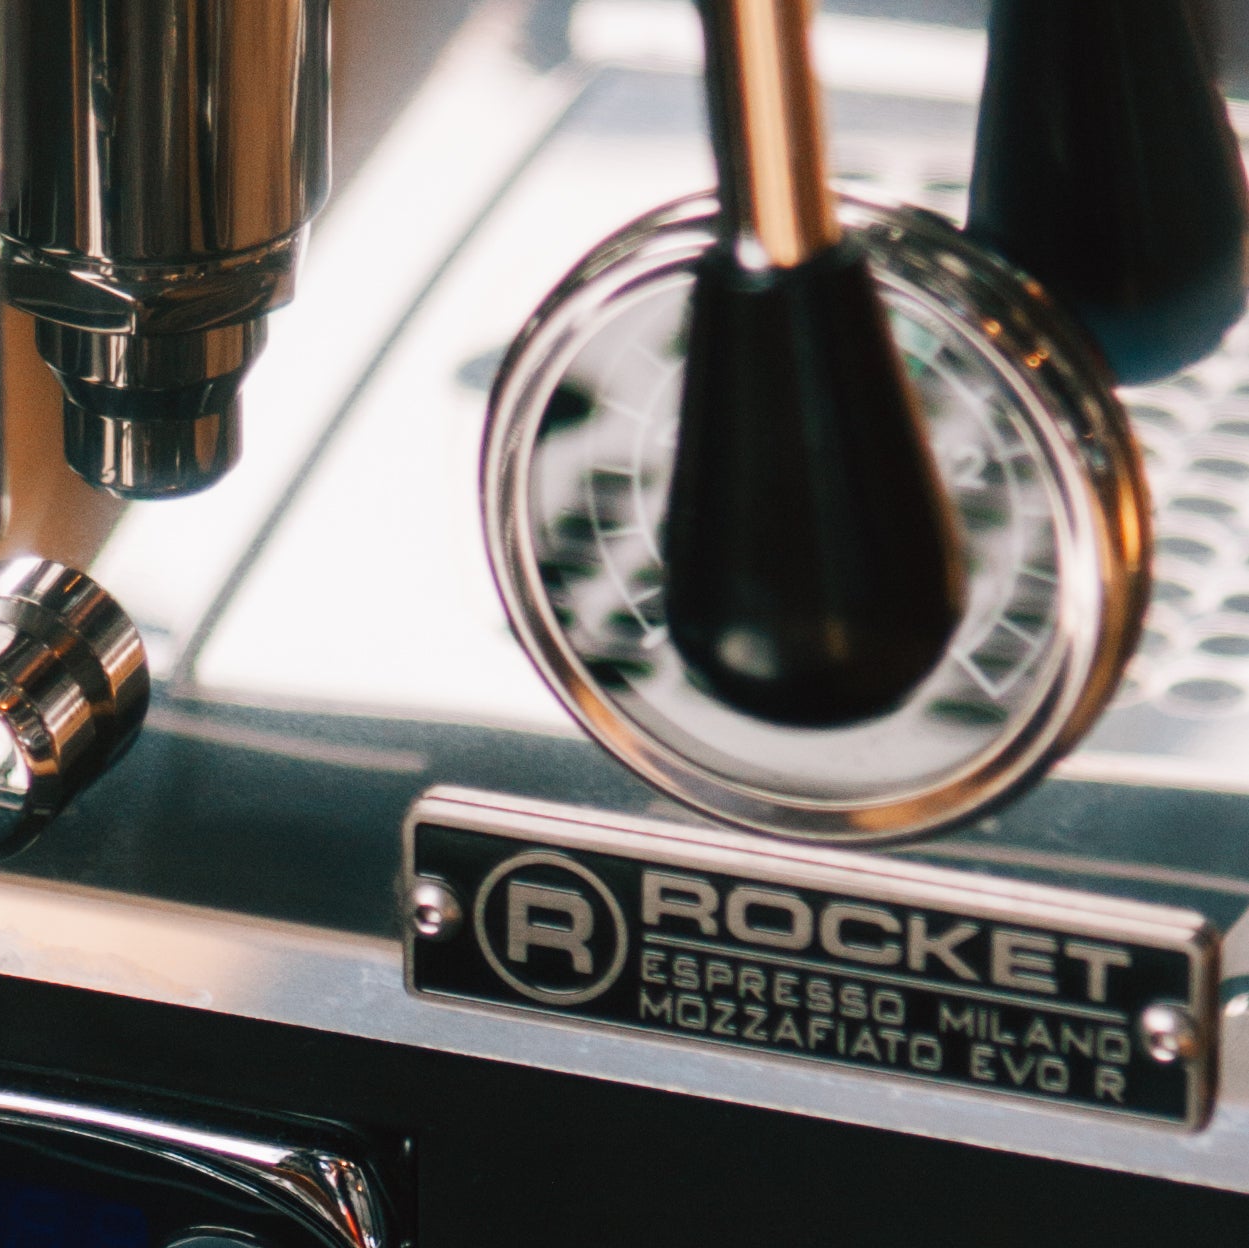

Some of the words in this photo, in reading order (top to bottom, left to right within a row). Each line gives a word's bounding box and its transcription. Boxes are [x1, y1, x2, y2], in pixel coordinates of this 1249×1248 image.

[641, 870, 1132, 1000] ROCKET
[639, 986, 943, 1072] MOZZAFIATO
[970, 1043, 1070, 1093] EVO
[1094, 1064, 1127, 1103] R
[641, 948, 906, 1026] ESPRESSO
[939, 1001, 1132, 1065] MILANO
